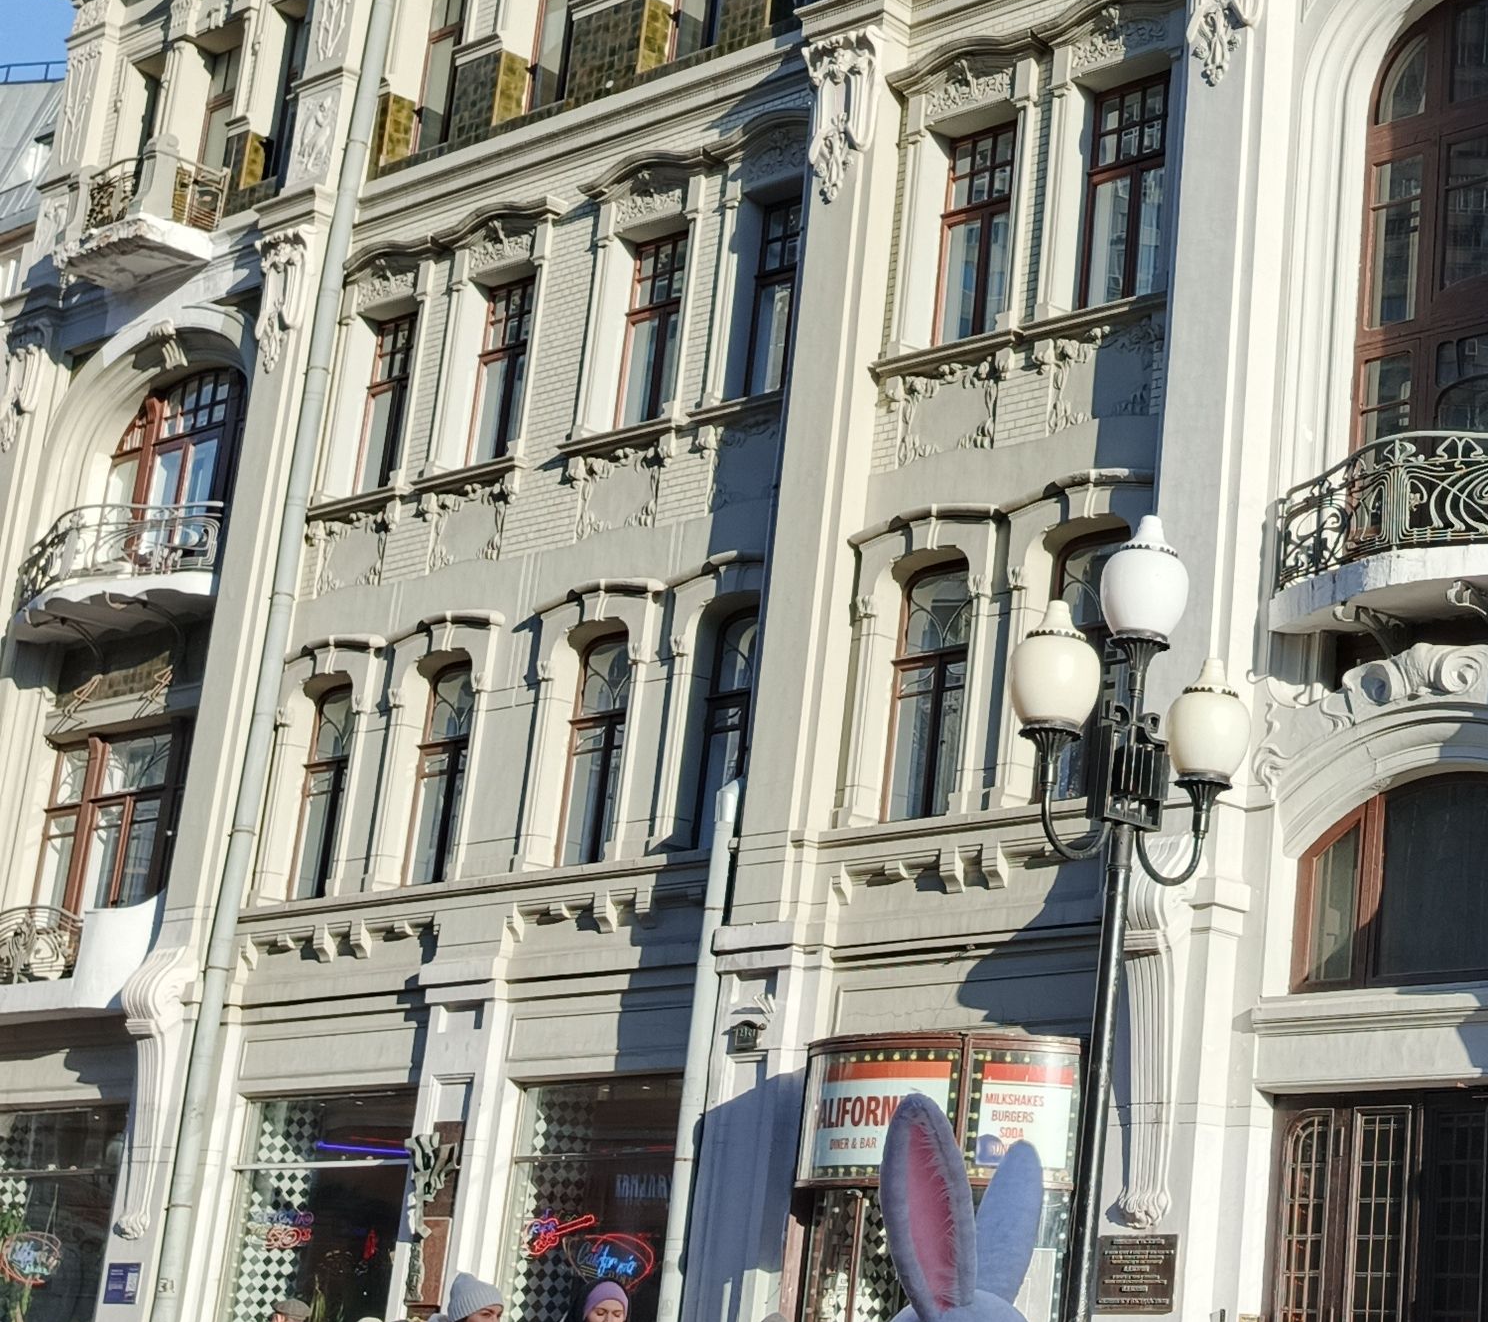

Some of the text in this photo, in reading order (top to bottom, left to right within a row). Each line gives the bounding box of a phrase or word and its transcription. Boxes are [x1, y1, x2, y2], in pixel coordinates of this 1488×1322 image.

[985, 1093, 1045, 1107] MILKSHAKES
[817, 1095, 906, 1130] ALIFORN
[992, 1110, 1034, 1123] BURGERS
[999, 1126, 1025, 1139] SODA
[829, 1137, 877, 1150] DINER & BAR
